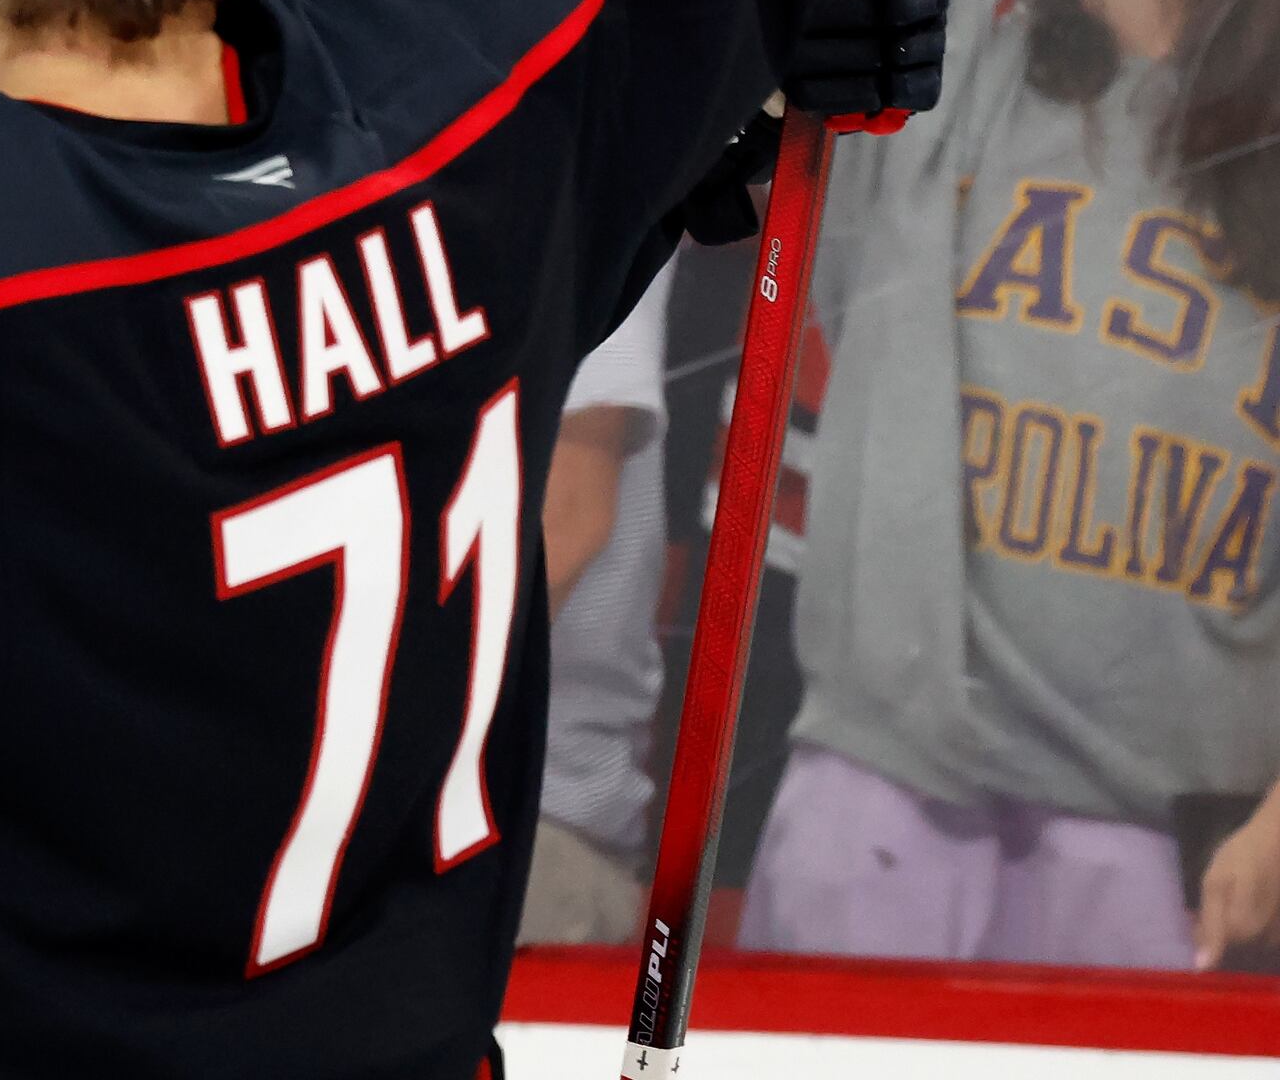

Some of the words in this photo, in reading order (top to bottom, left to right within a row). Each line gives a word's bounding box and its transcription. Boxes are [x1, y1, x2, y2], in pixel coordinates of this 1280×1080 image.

[184, 201, 490, 448] HALL
[761, 275, 778, 302] 8
[767, 237, 782, 277] PRO
[210, 376, 523, 978] 71
